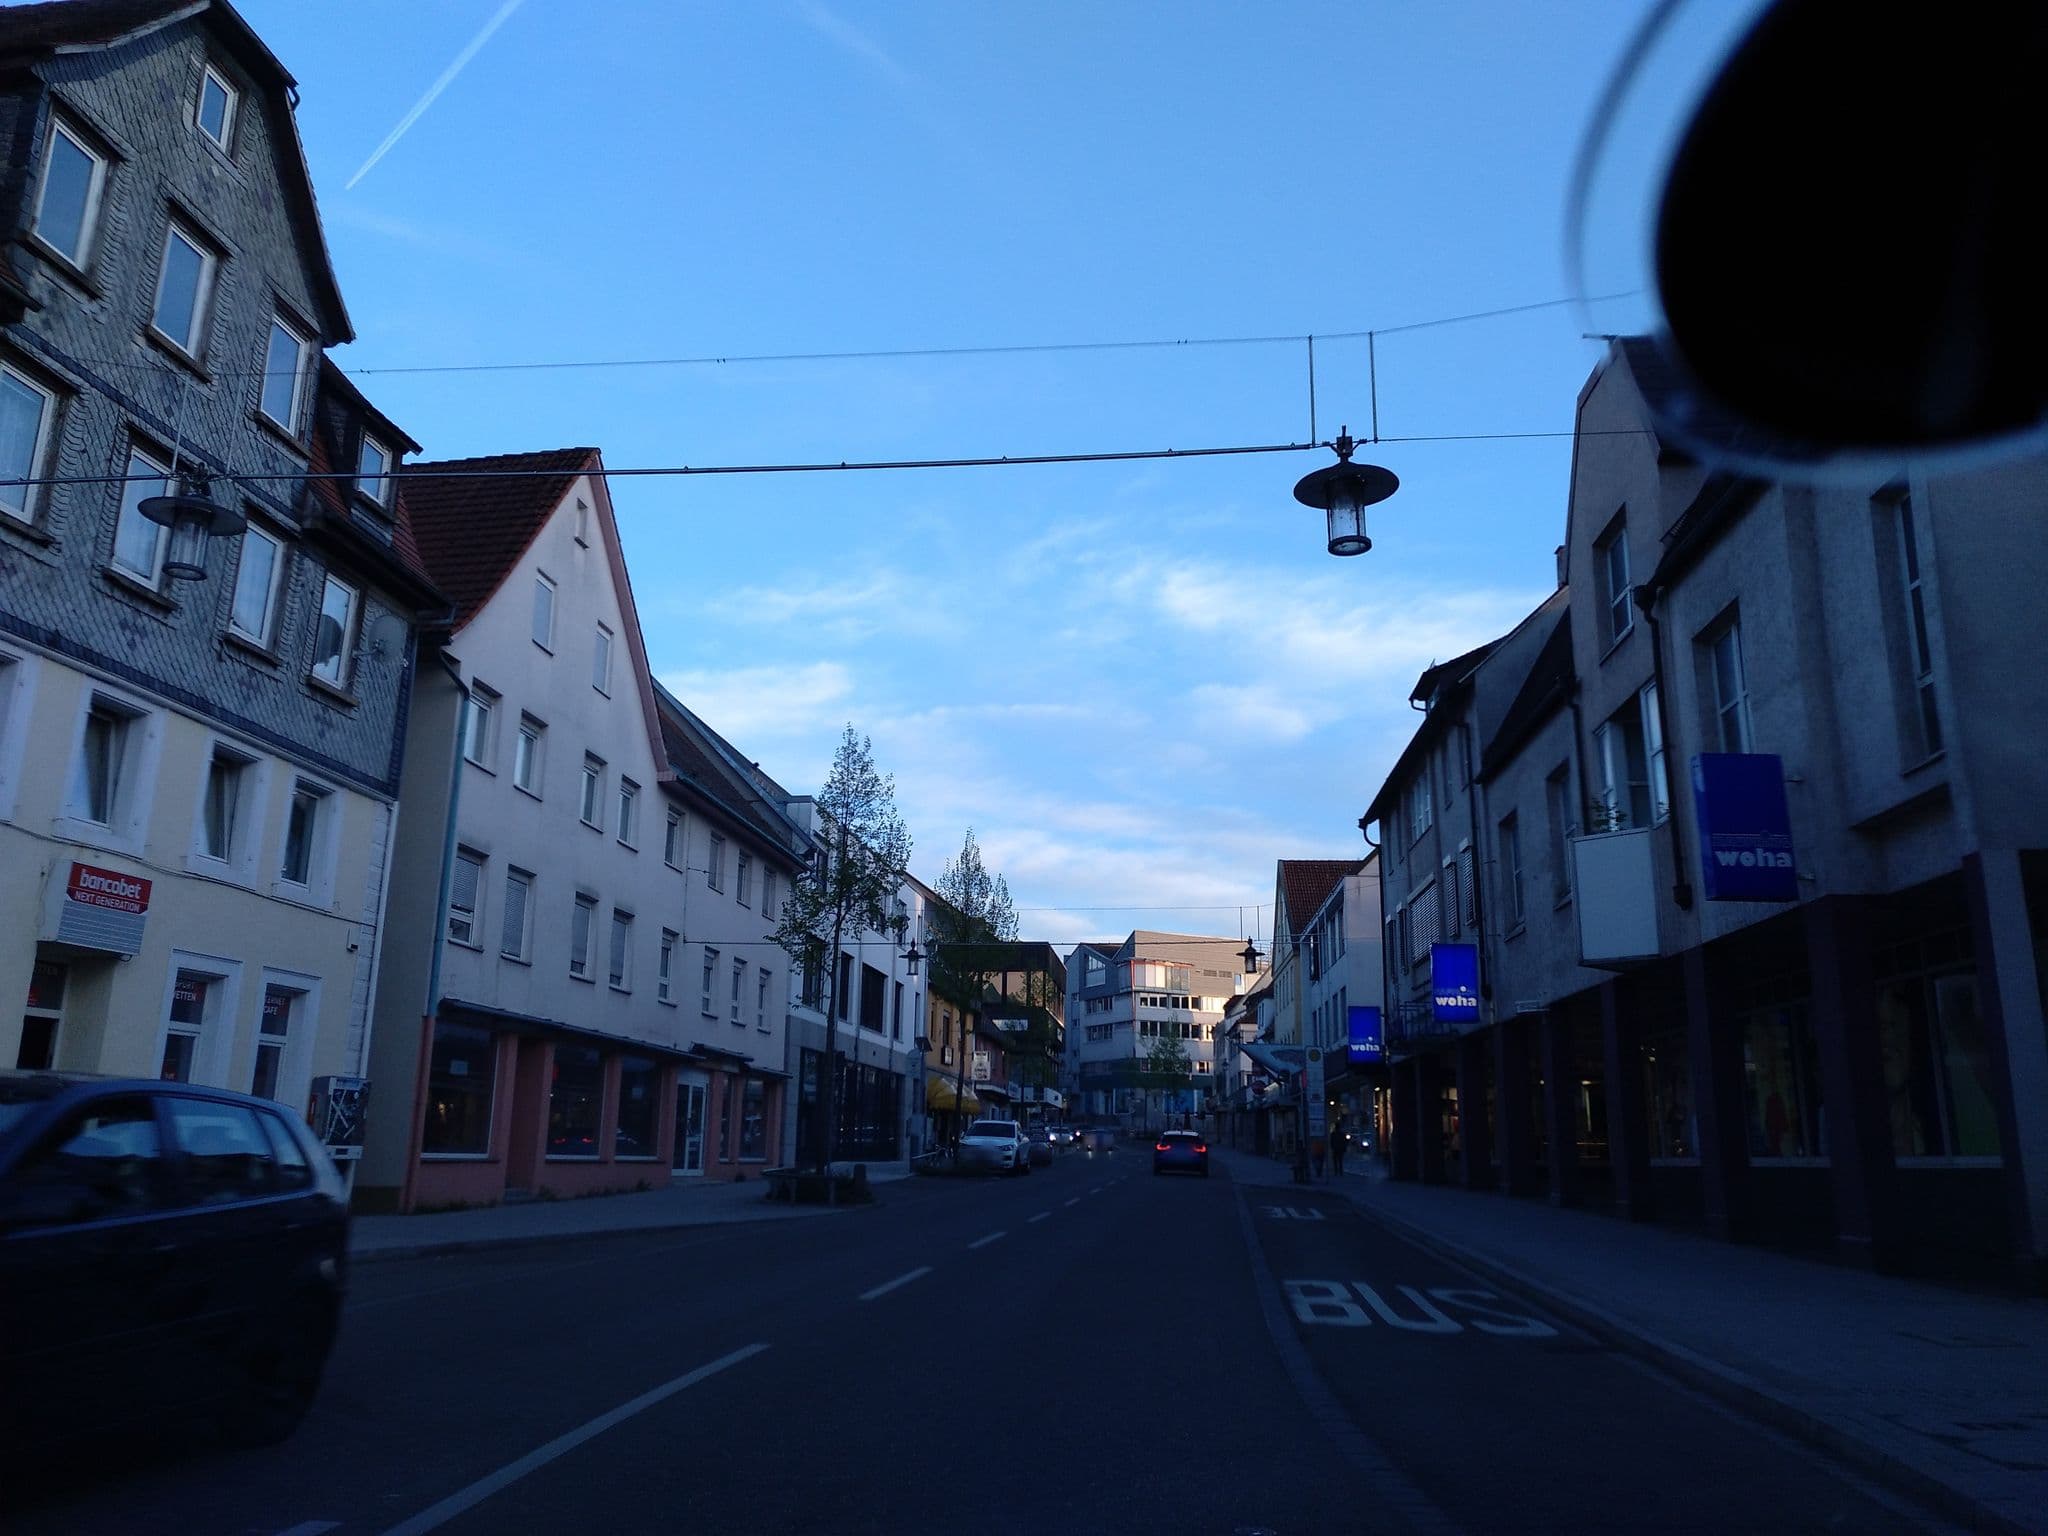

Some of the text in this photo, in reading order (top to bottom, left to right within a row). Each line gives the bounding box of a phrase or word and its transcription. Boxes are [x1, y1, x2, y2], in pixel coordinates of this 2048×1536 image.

[1714, 848, 1793, 867] woha
[79, 868, 142, 899] bancobet
[74, 889, 141, 912] NEXT GENERATION
[1435, 994, 1478, 1007] woha
[1350, 1042, 1381, 1052] woha
[1283, 1279, 1560, 1337] BUS
